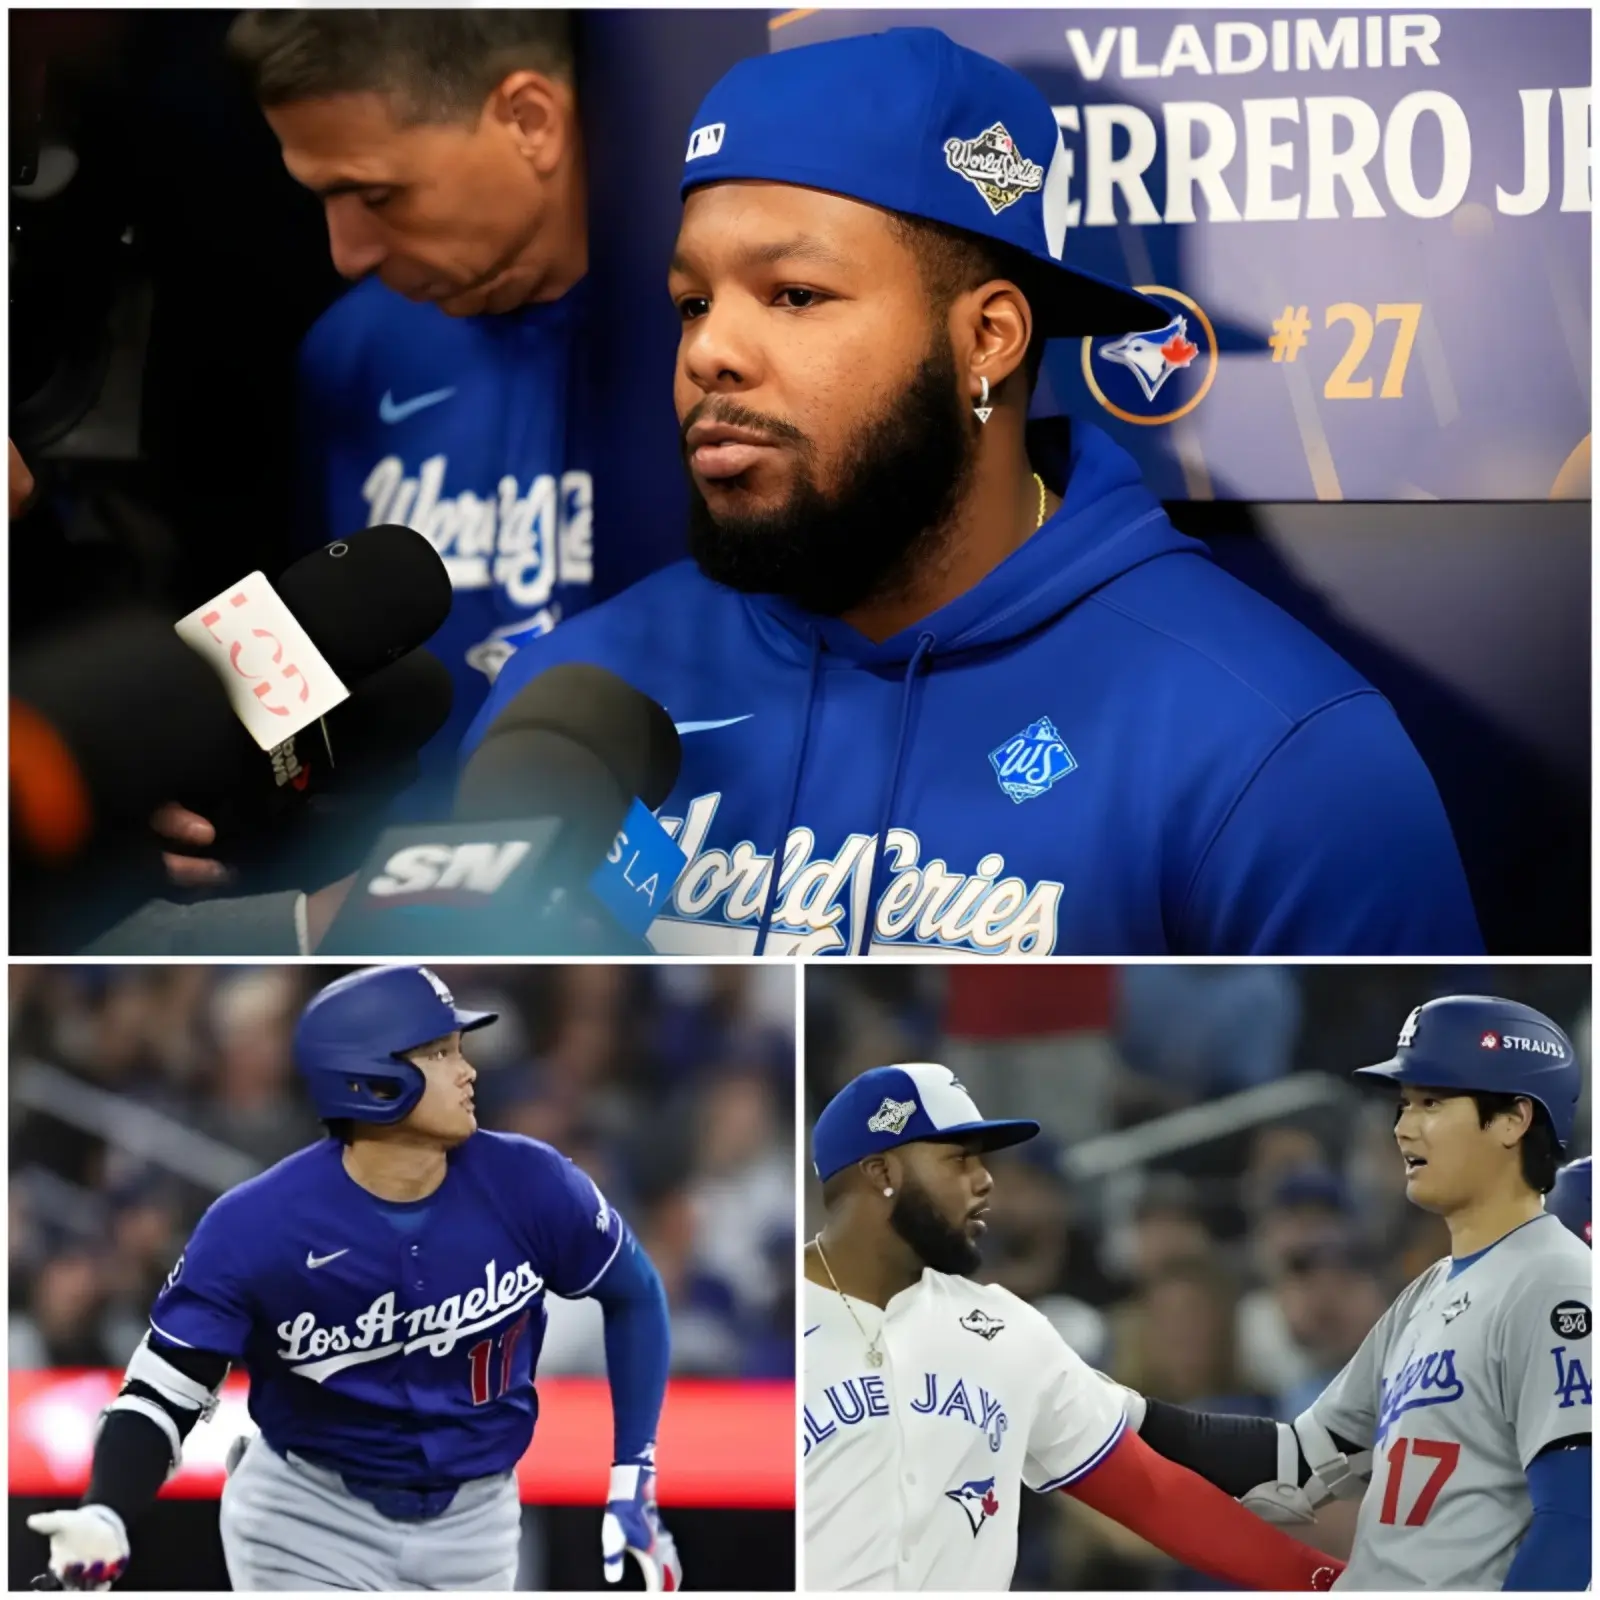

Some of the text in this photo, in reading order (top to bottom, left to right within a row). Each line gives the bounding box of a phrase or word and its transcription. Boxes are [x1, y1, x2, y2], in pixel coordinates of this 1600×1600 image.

[1066, 14, 1441, 80] VLADIMIR
[1000, 739, 1065, 786] WS
[367, 841, 532, 897] SN
[846, 827, 1065, 956] Series
[1503, 1035, 1565, 1059] STRAUSS
[277, 1258, 544, 1361] Los Angeles
[804, 1372, 1008, 1457] LUE JAYS
[1379, 1437, 1461, 1527] 17
